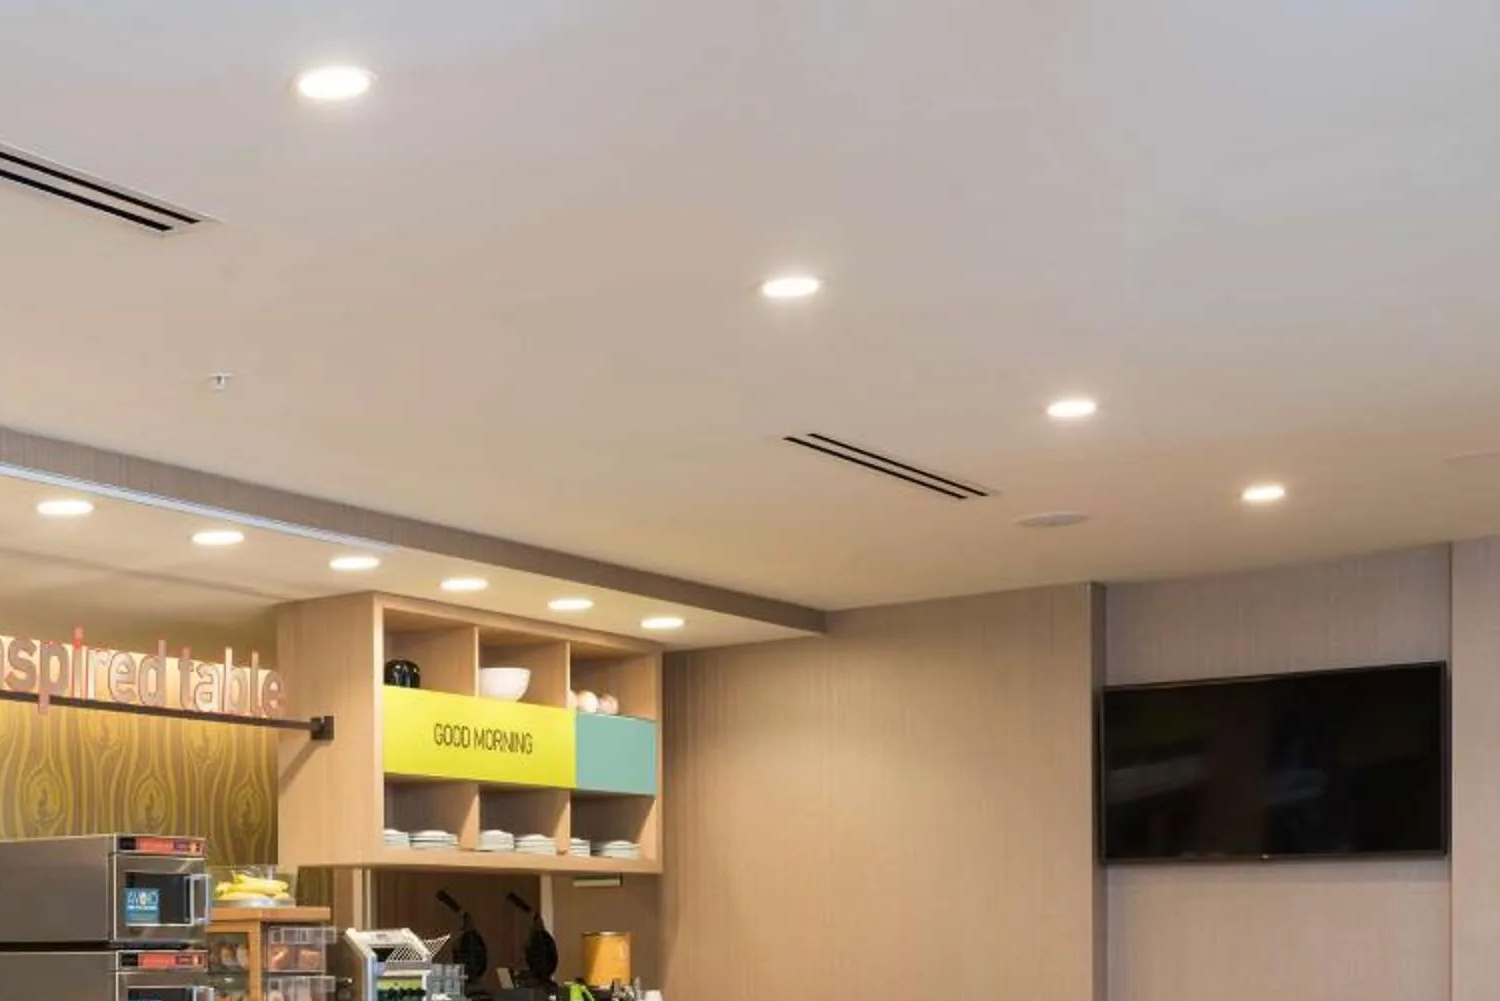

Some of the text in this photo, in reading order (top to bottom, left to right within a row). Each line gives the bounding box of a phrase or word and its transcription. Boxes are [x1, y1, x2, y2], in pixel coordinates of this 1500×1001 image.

[179, 645, 284, 719] table
[433, 722, 534, 755] GOOD MORNING
